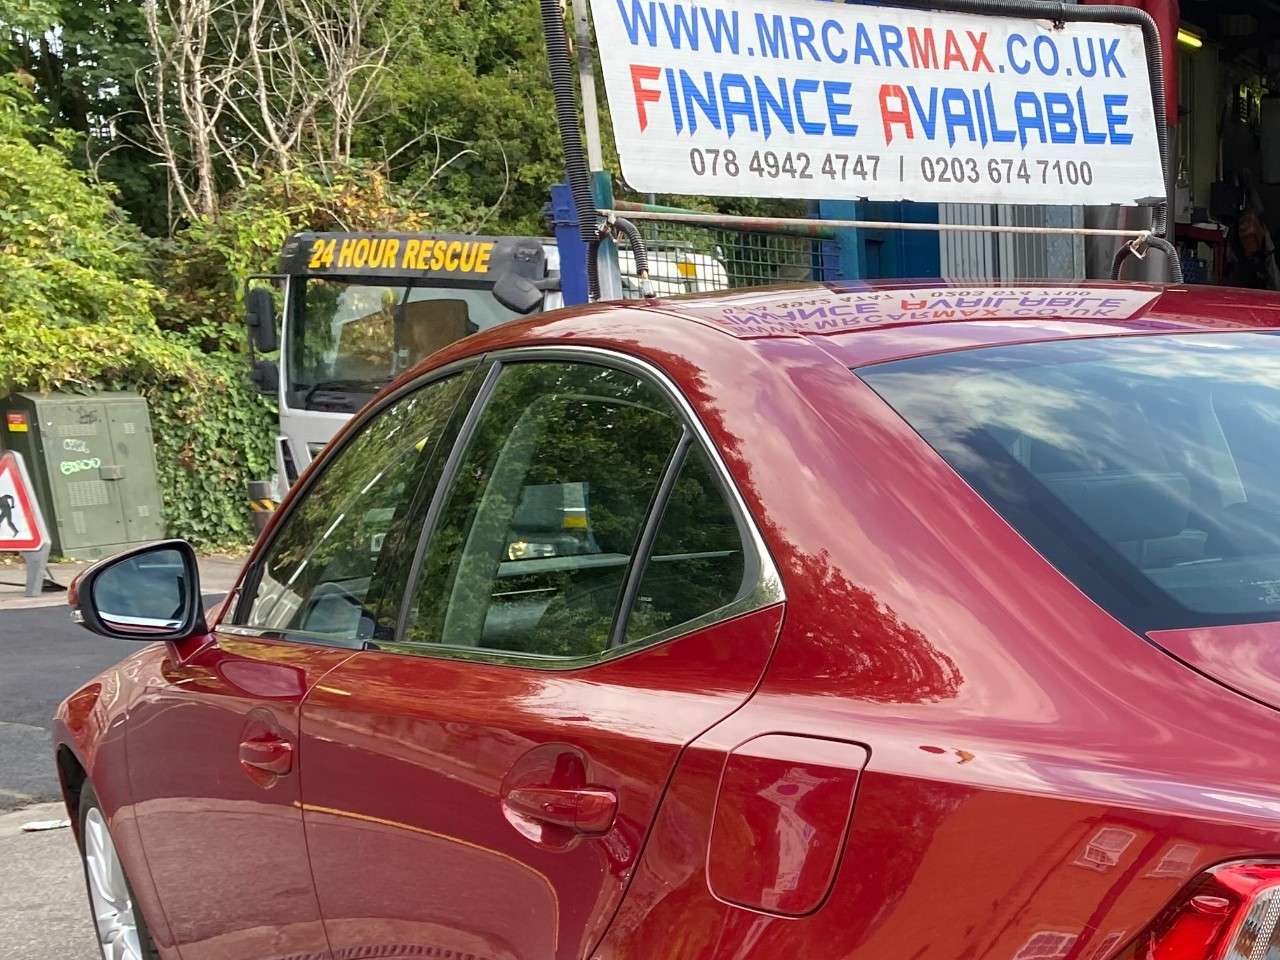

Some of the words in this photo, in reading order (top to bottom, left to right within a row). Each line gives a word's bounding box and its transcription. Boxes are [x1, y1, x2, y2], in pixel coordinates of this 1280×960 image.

[616, 0, 1127, 78] WWW.MRCARMAX.CO.UK
[629, 64, 859, 141] FINANCE
[879, 81, 1134, 151] AVAILABLE
[690, 147, 740, 177] 078
[749, 150, 813, 179] 4942
[821, 153, 880, 181] 4747
[920, 156, 980, 183] 0203
[987, 159, 1031, 184] 674
[1036, 160, 1093, 186] 7100
[308, 239, 337, 269] 24
[337, 238, 400, 269] HOUR
[402, 239, 495, 273] RESCUE
